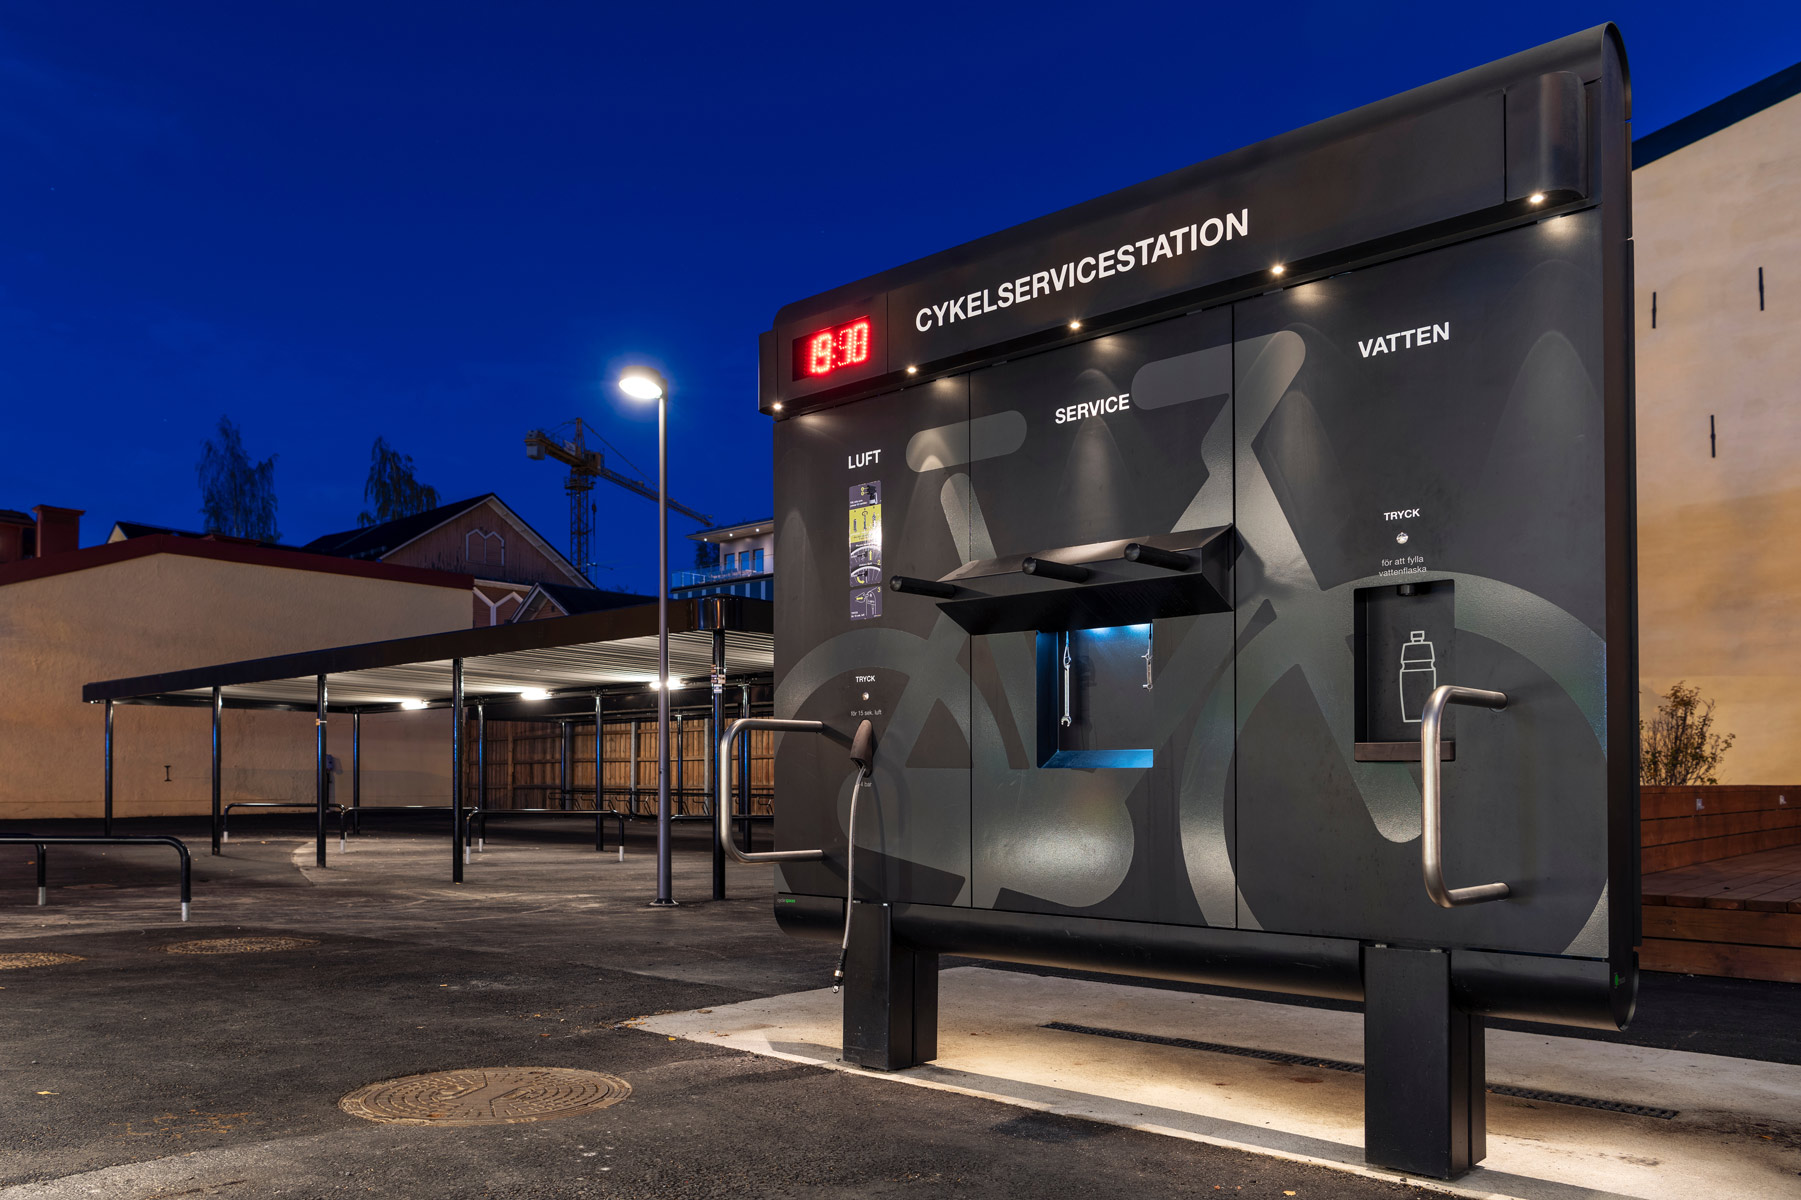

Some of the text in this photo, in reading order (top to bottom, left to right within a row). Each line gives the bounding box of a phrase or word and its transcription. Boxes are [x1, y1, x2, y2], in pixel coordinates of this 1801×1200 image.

[915, 208, 1250, 333] CYKELSERVICESTATION
[1357, 321, 1450, 358] VATTEN
[1054, 393, 1130, 425] SERVICE
[848, 449, 882, 469] LUFT
[1383, 508, 1421, 521] TRYCK
[1381, 555, 1424, 567] för att fylla
[1378, 565, 1427, 577] vattenflaska
[855, 675, 876, 683] TRYCK
